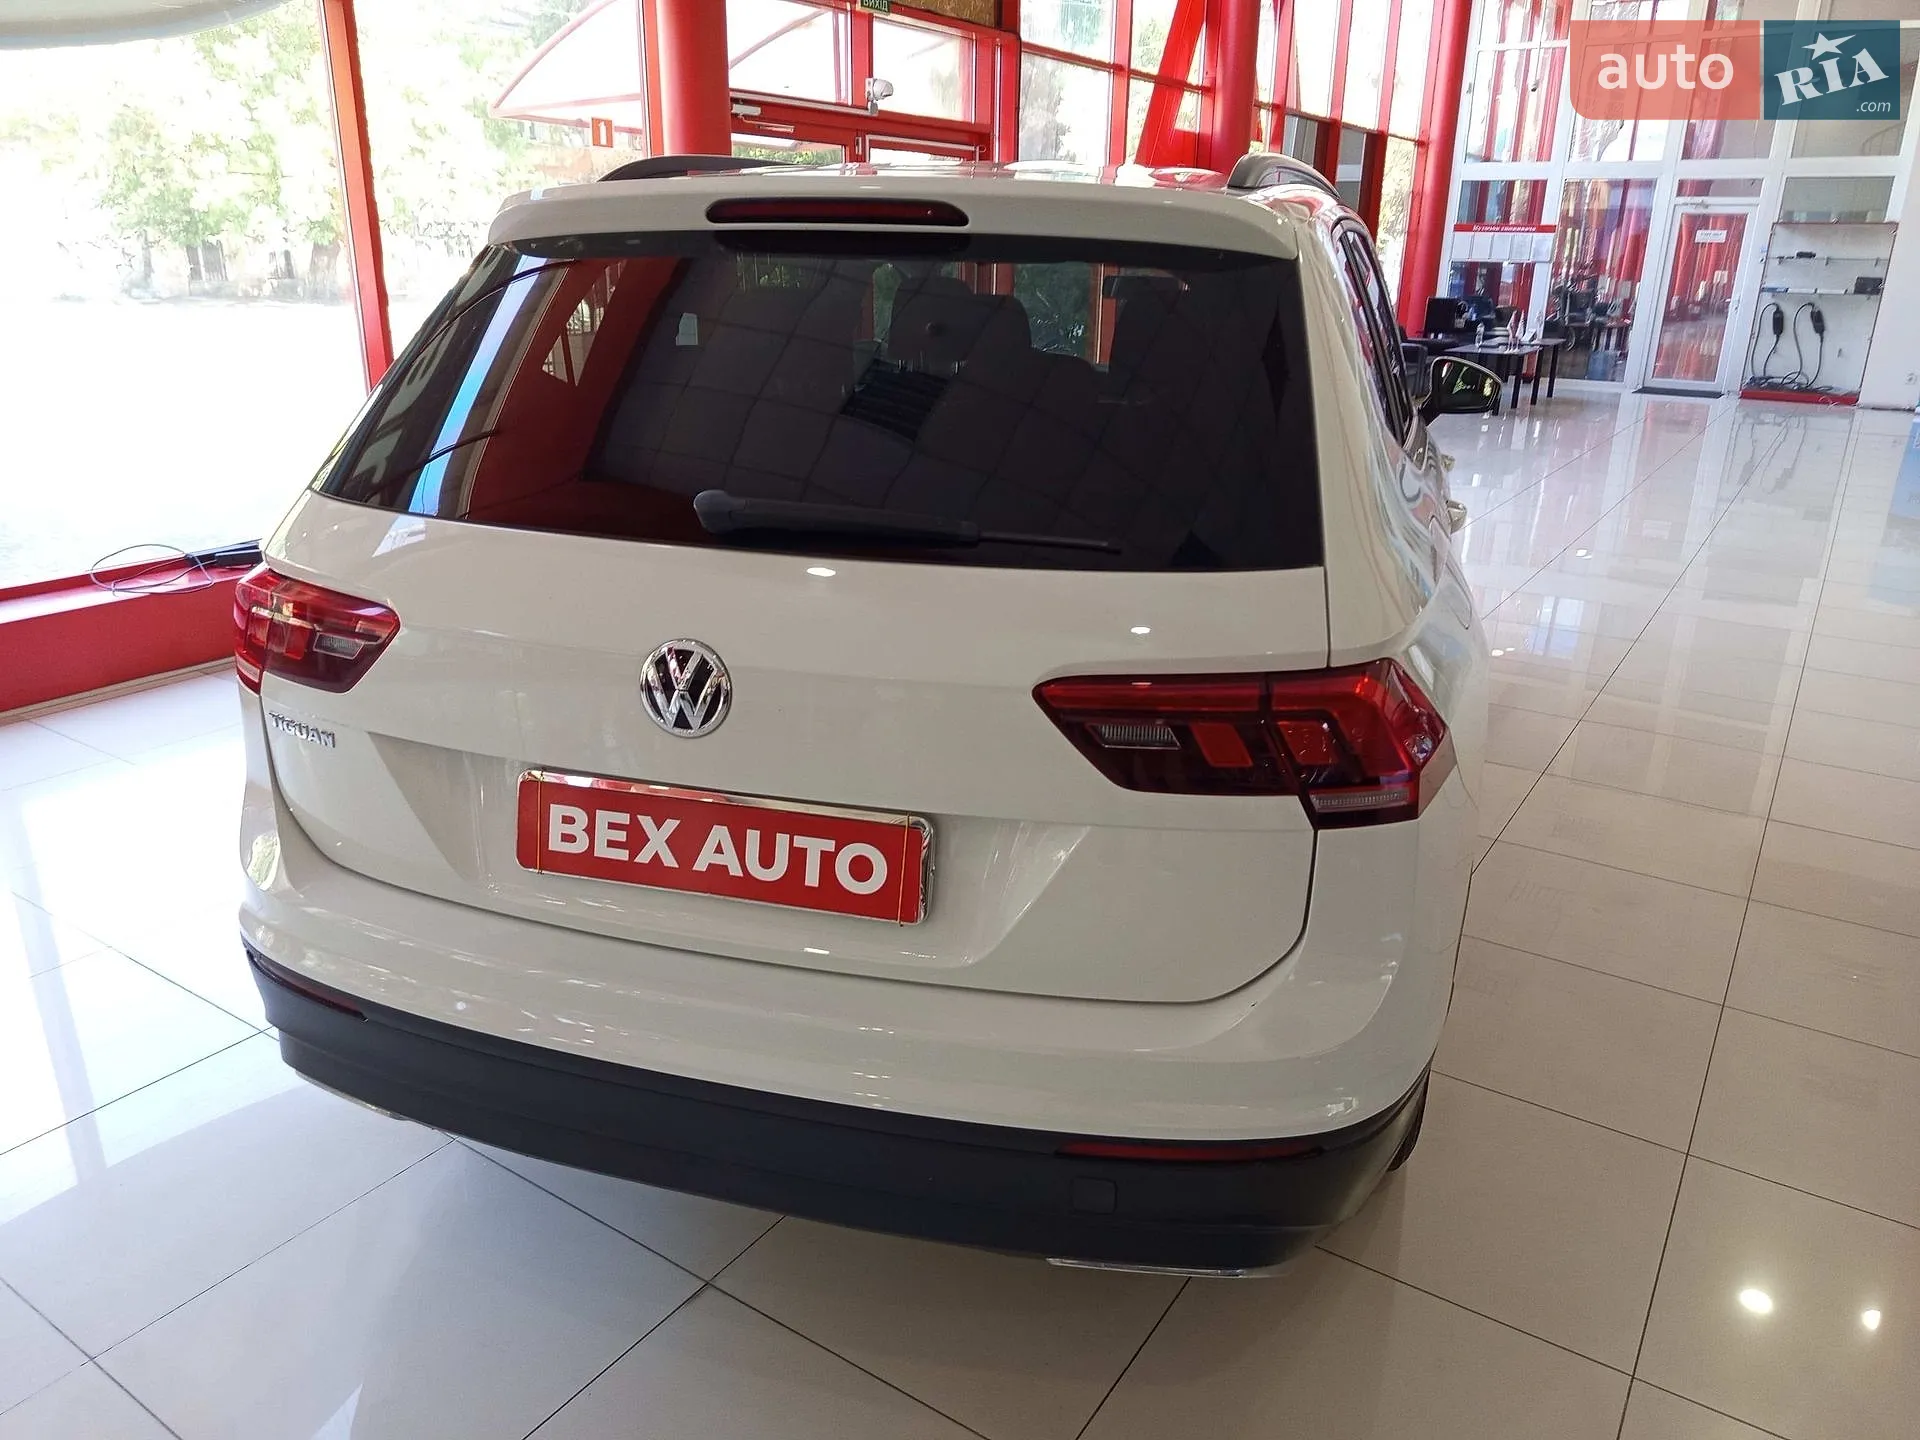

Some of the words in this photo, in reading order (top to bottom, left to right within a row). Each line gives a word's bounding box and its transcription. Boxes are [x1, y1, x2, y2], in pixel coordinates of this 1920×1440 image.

[269, 711, 336, 748] TIGUAN
[548, 803, 679, 869] BEX
[691, 825, 888, 895] AUTO
